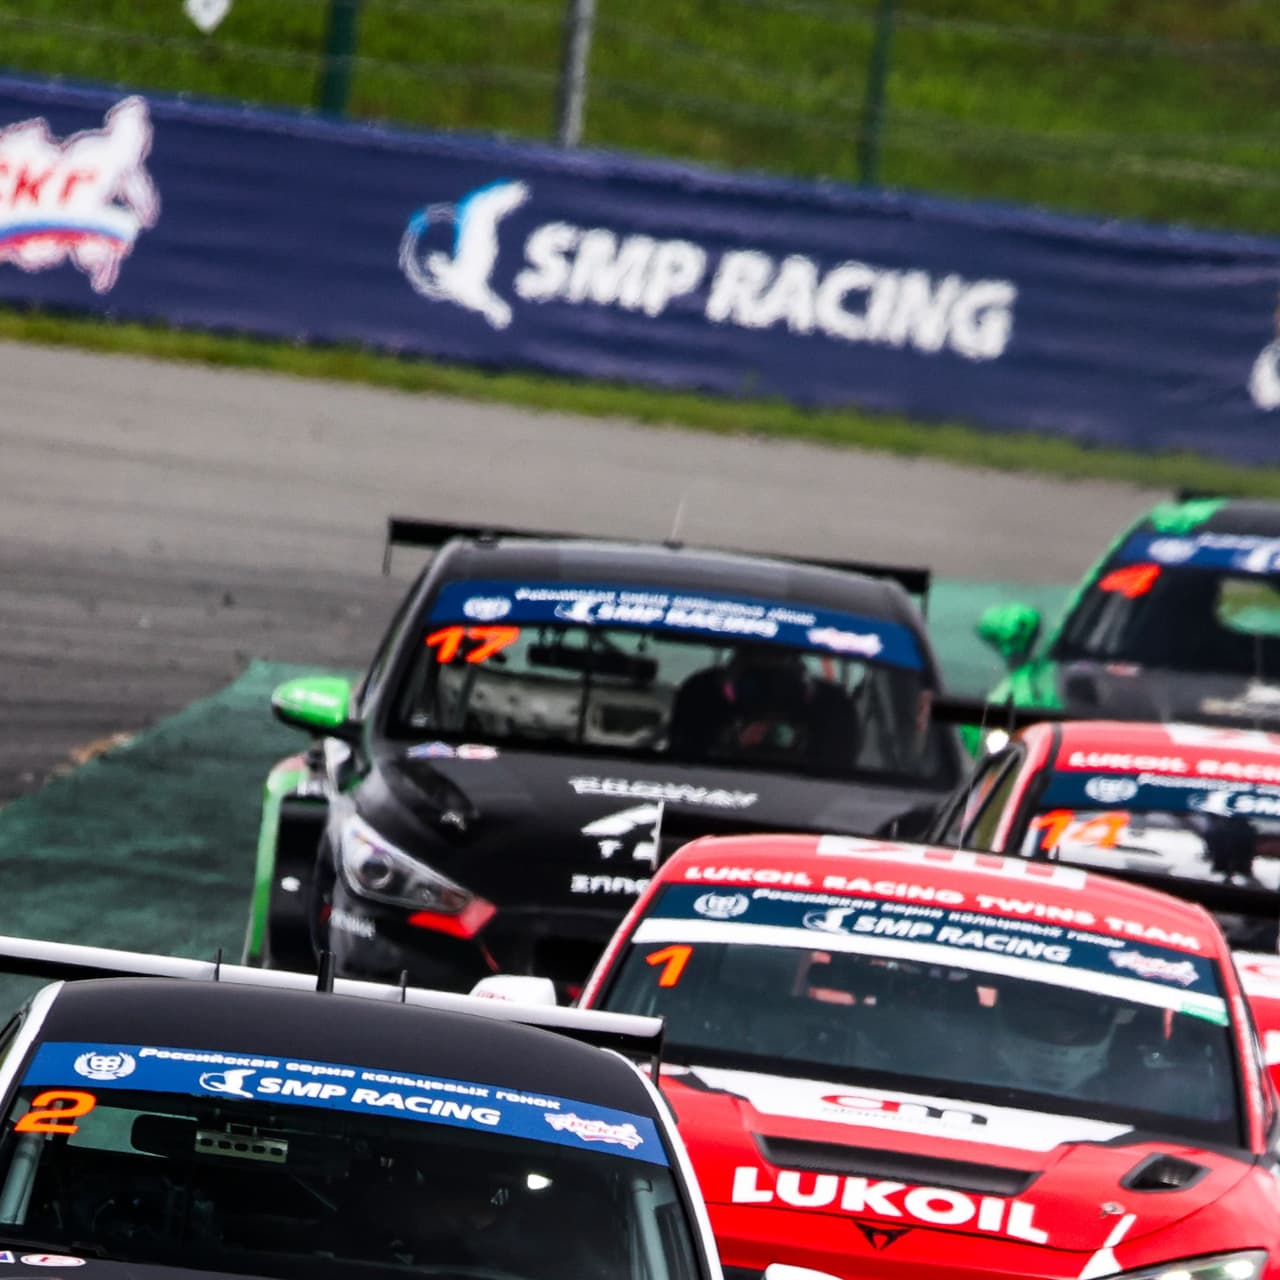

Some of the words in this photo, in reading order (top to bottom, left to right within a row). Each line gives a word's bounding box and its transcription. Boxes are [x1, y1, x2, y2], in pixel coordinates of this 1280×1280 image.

[515, 221, 707, 317] SMP
[705, 249, 1018, 360] RACING
[426, 626, 520, 664] 17
[1030, 809, 1131, 850] 14
[685, 867, 812, 887] LUKOIL
[822, 875, 964, 905] RACING
[976, 894, 1096, 926] TWINS
[1104, 916, 1200, 951] TEAM
[853, 915, 934, 938] SMP
[935, 925, 1071, 963] RACING
[646, 945, 693, 988] 1
[139, 1048, 279, 1070] Российская
[362, 1071, 489, 1098] кольцевых
[496, 1090, 561, 1110] гонок
[257, 1077, 346, 1100] SMP
[350, 1087, 502, 1127] RACING
[15, 1090, 97, 1134] 2
[732, 1166, 1049, 1245] LUKOIL
